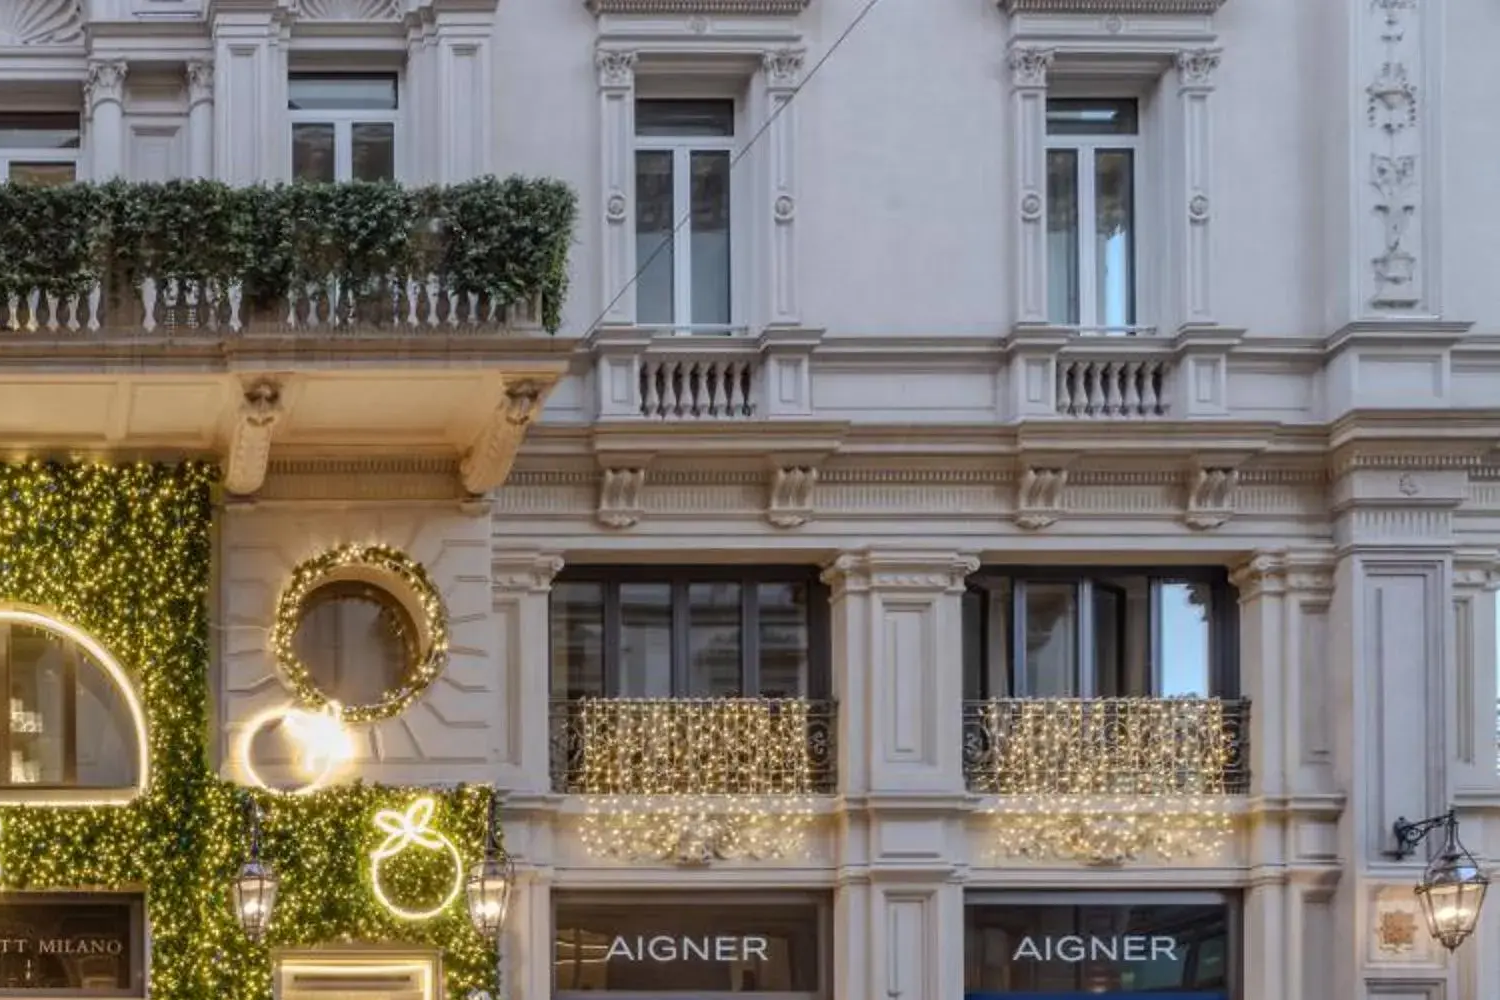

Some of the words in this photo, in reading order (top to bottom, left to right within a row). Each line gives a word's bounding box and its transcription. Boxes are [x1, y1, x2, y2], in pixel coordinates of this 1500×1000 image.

[39, 937, 123, 955] MILANO
[605, 935, 769, 962] AIGNER
[1012, 935, 1178, 962] AIGNER
